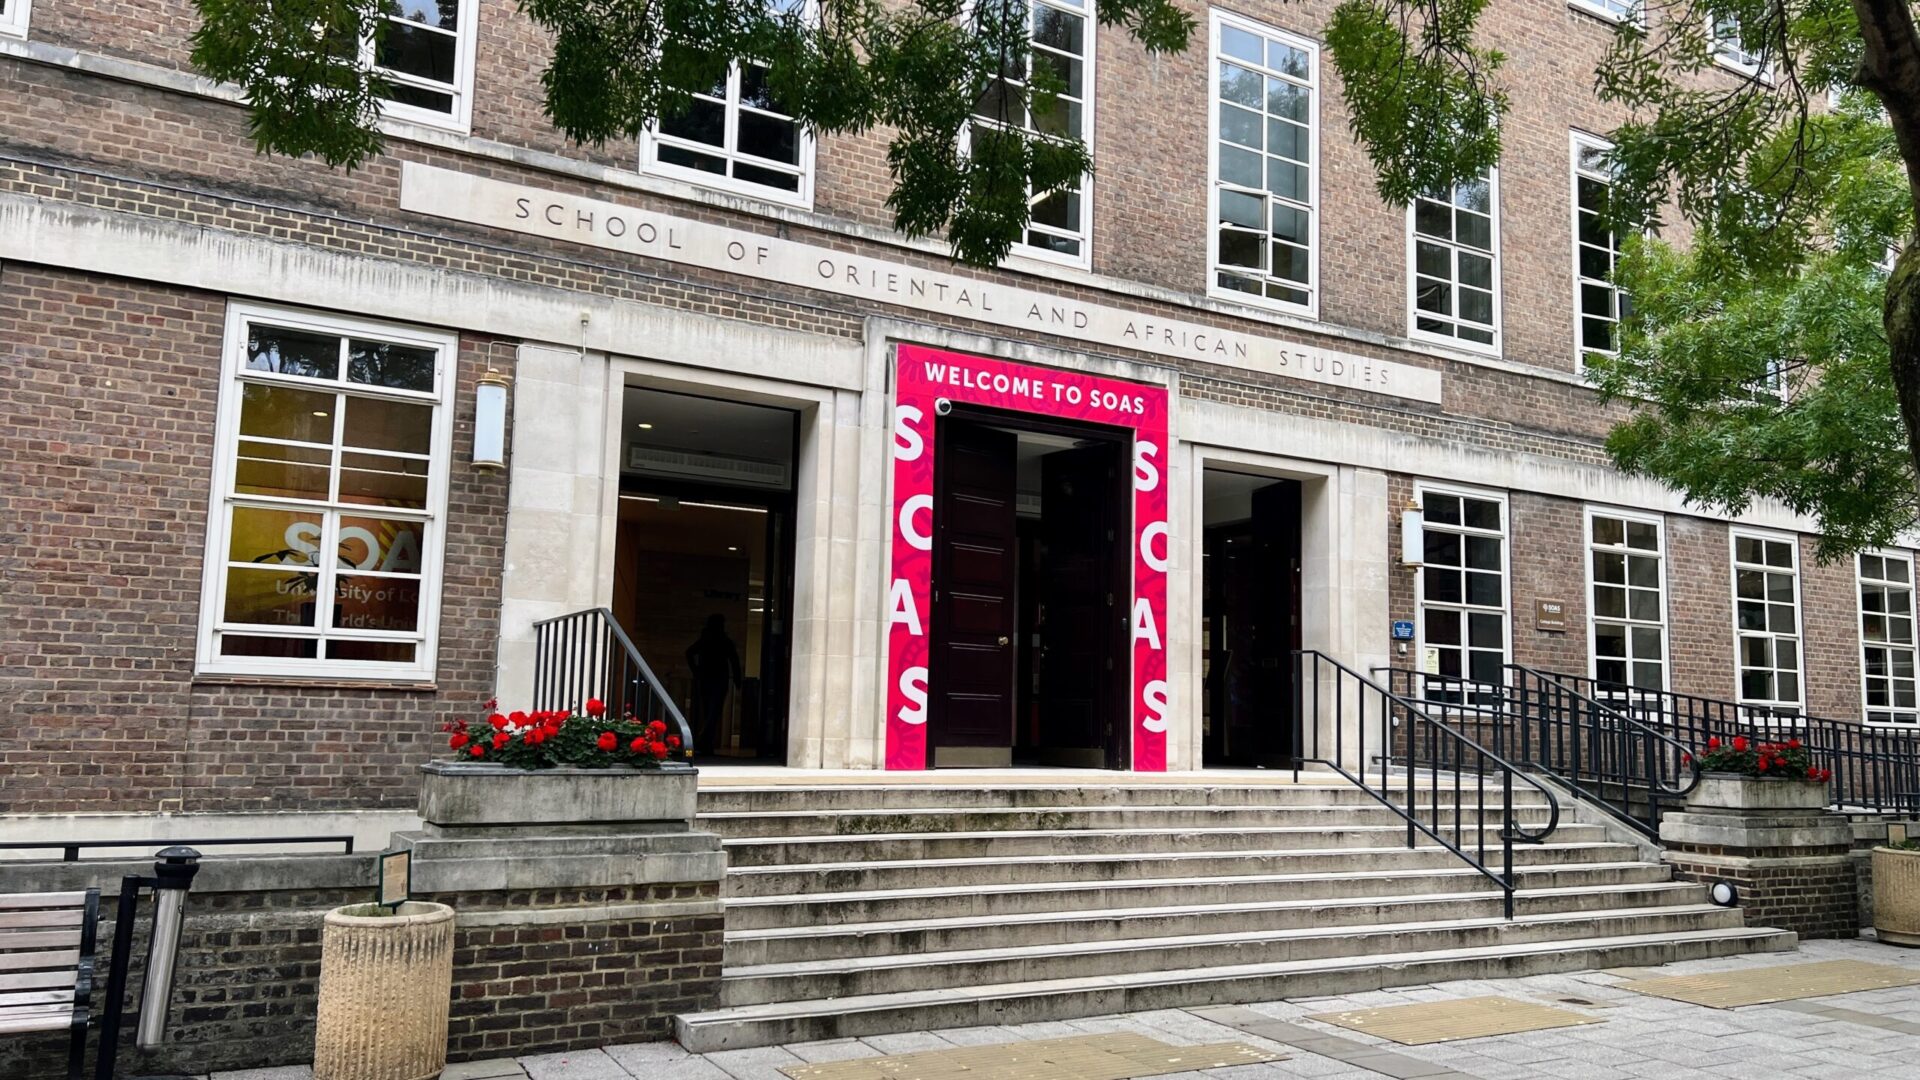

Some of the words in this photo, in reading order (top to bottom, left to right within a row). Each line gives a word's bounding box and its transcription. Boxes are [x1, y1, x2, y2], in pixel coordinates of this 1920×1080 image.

[515, 198, 682, 249] SCHOOL
[727, 241, 769, 264] OF
[817, 259, 993, 312] ORIENTAL
[1027, 303, 1089, 329] AND
[1123, 321, 1248, 357] AFRICAN
[1279, 350, 1389, 385] STUDIES
[924, 361, 1044, 399] WELCOME
[1051, 383, 1082, 405] TO
[1090, 390, 1145, 415] SOAS
[272, 608, 302, 626] Th
[375, 587, 397, 602] of
[889, 404, 934, 724] SOAS
[1133, 440, 1168, 733] SOAS
